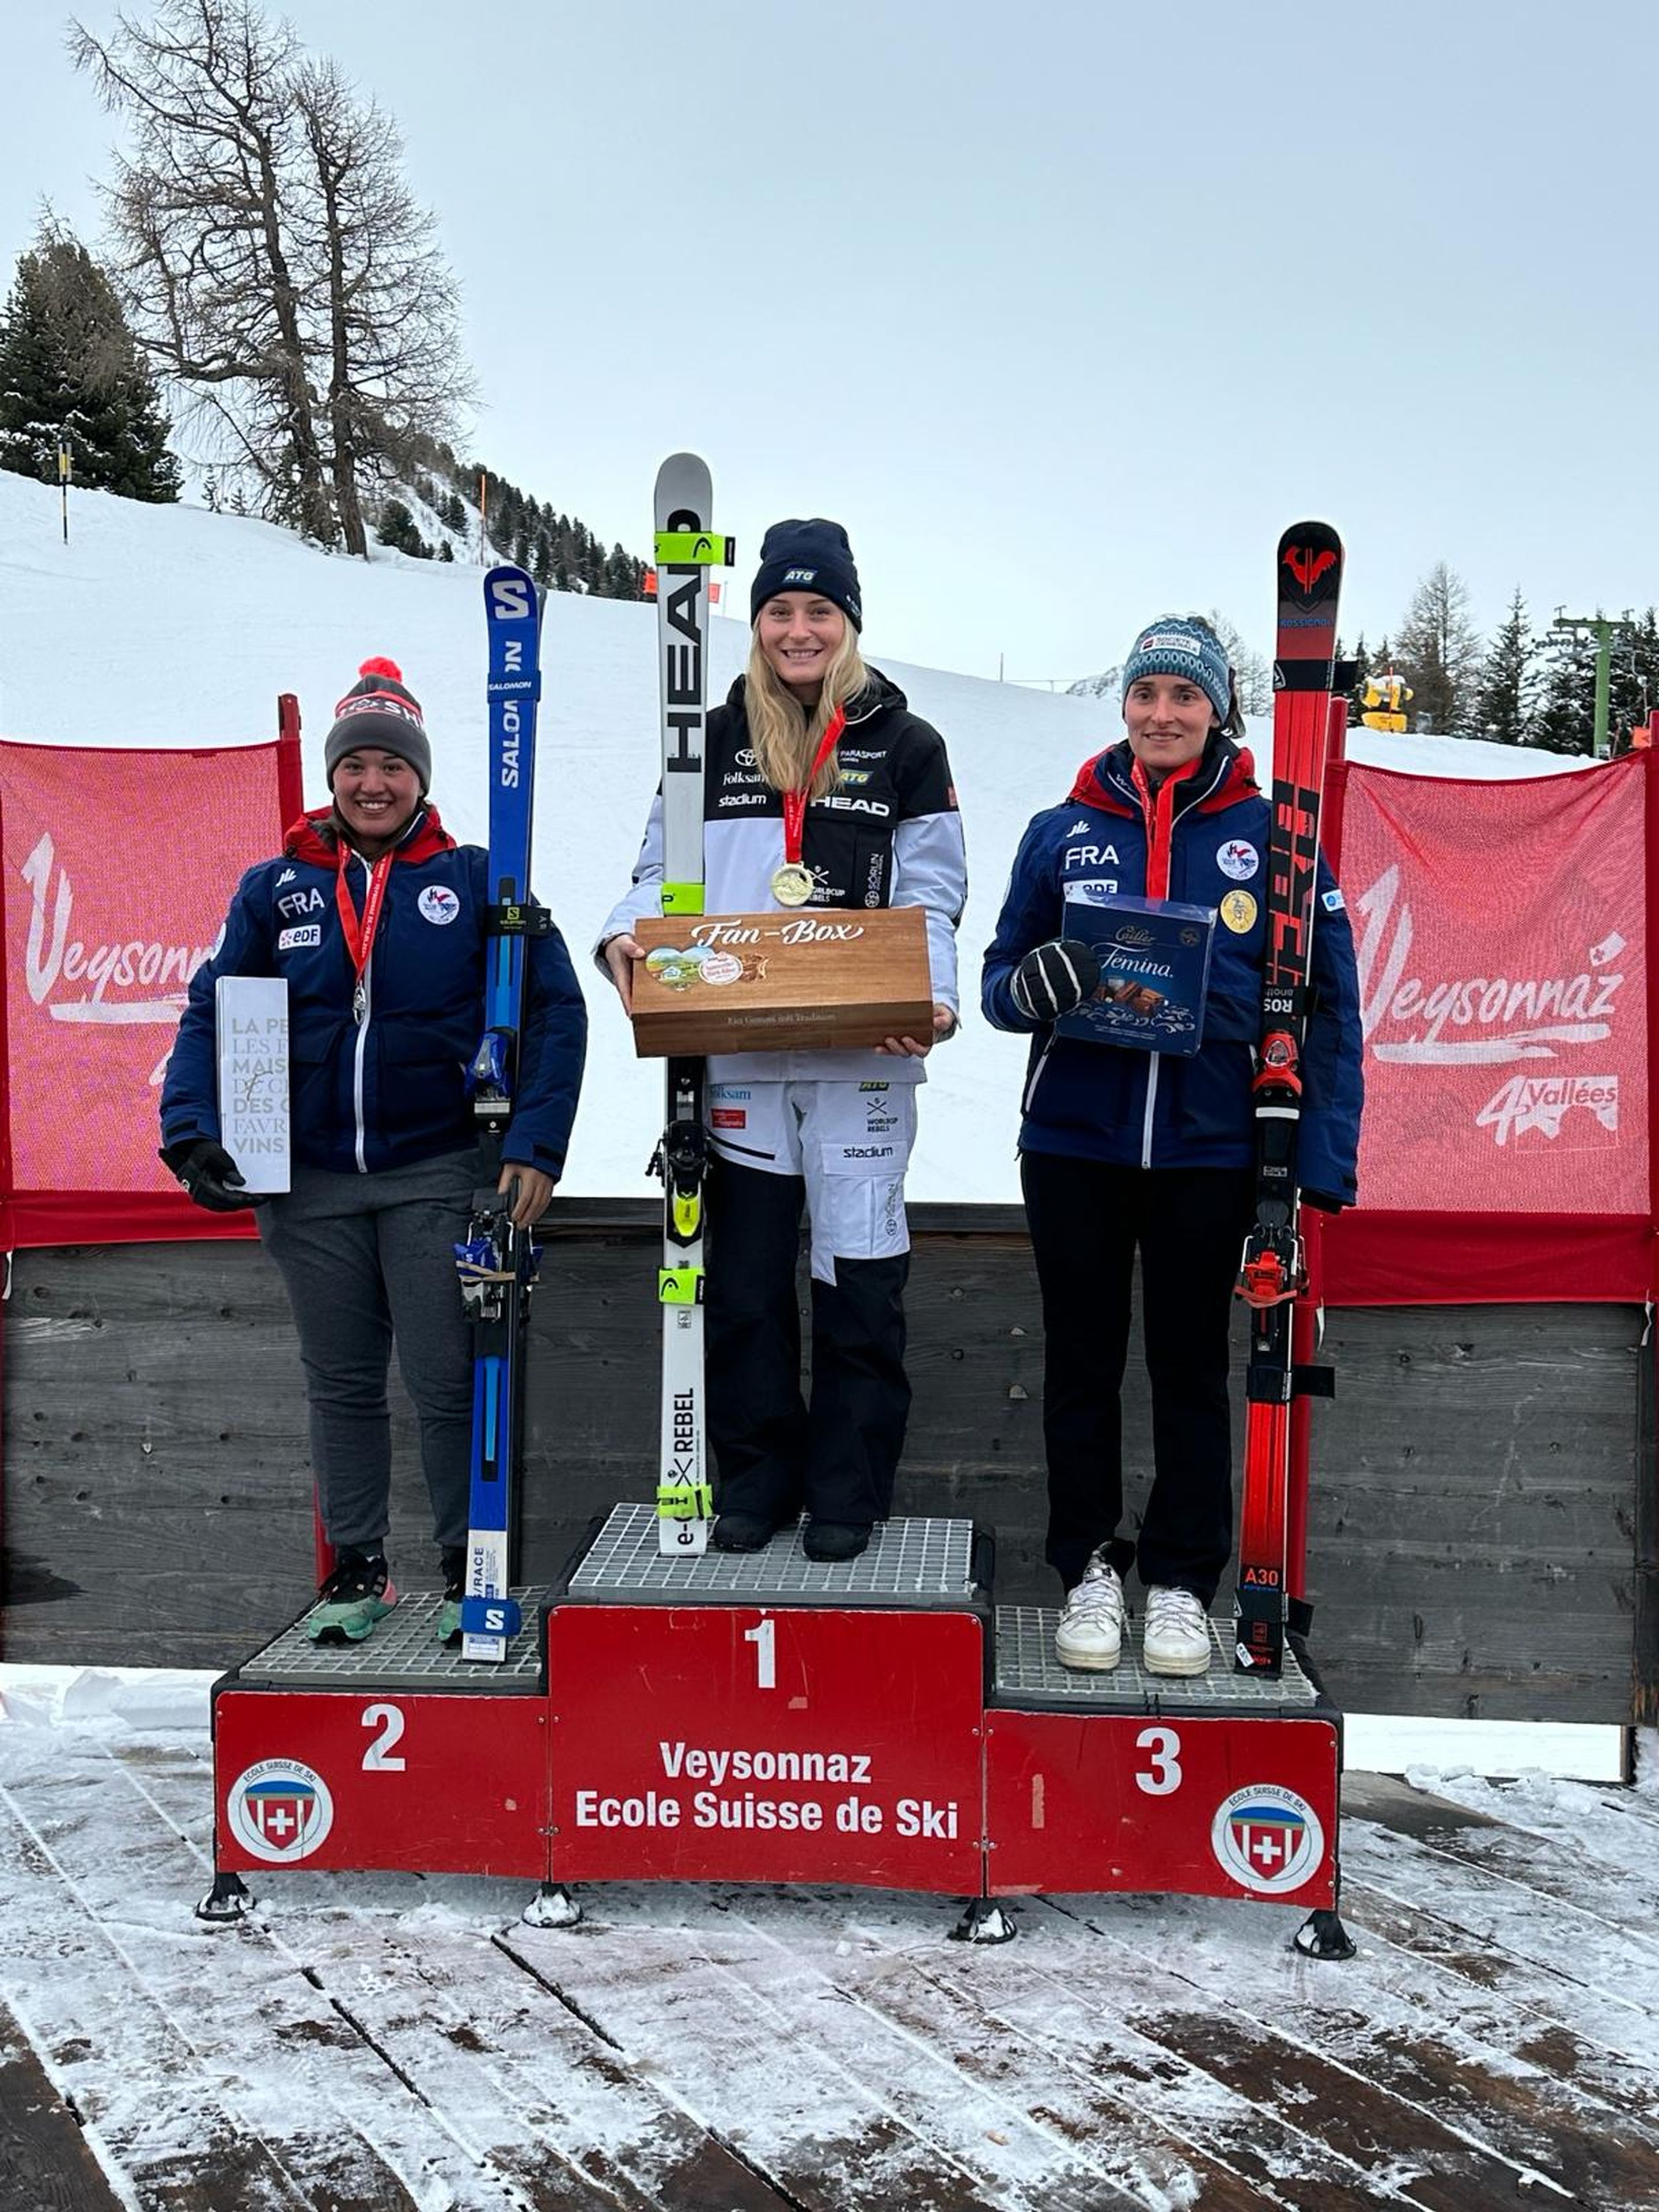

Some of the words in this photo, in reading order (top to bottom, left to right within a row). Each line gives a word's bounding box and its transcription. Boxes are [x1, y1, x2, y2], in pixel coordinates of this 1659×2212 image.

[784, 570, 815, 581] ATG
[488, 681, 532, 691] SALOMON
[718, 793, 767, 807] stadium
[810, 795, 890, 817] HEAD
[1065, 844, 1120, 870] FRA
[278, 888, 325, 919] FRA
[293, 928, 319, 944] eDF
[232, 1018, 259, 1035] LA
[233, 1038, 271, 1055] LES
[234, 1097, 274, 1114] DES
[234, 1138, 285, 1154] VINS
[843, 1146, 893, 1159] stadium
[674, 1387, 694, 1453] REBEL
[1244, 1567, 1279, 1586] A30
[745, 1619, 775, 1688] 1
[361, 1703, 406, 1772] 2
[243, 1764, 265, 1782] ECOLE
[266, 1760, 293, 1770] SUISSE
[293, 1764, 304, 1774] DE
[304, 1770, 317, 1782] SKI
[660, 1741, 872, 1786] Veysonnaz
[1135, 1726, 1183, 1796] 3
[1228, 1789, 1252, 1806] ECOLE
[1253, 1786, 1282, 1796] SUISSE
[1282, 1791, 1294, 1802] DE
[1293, 1798, 1308, 1812] SKI
[576, 1790, 681, 1828] Ecole
[693, 1791, 823, 1830] Suisse
[836, 1796, 882, 1833] de
[896, 1799, 958, 1839] Ski
